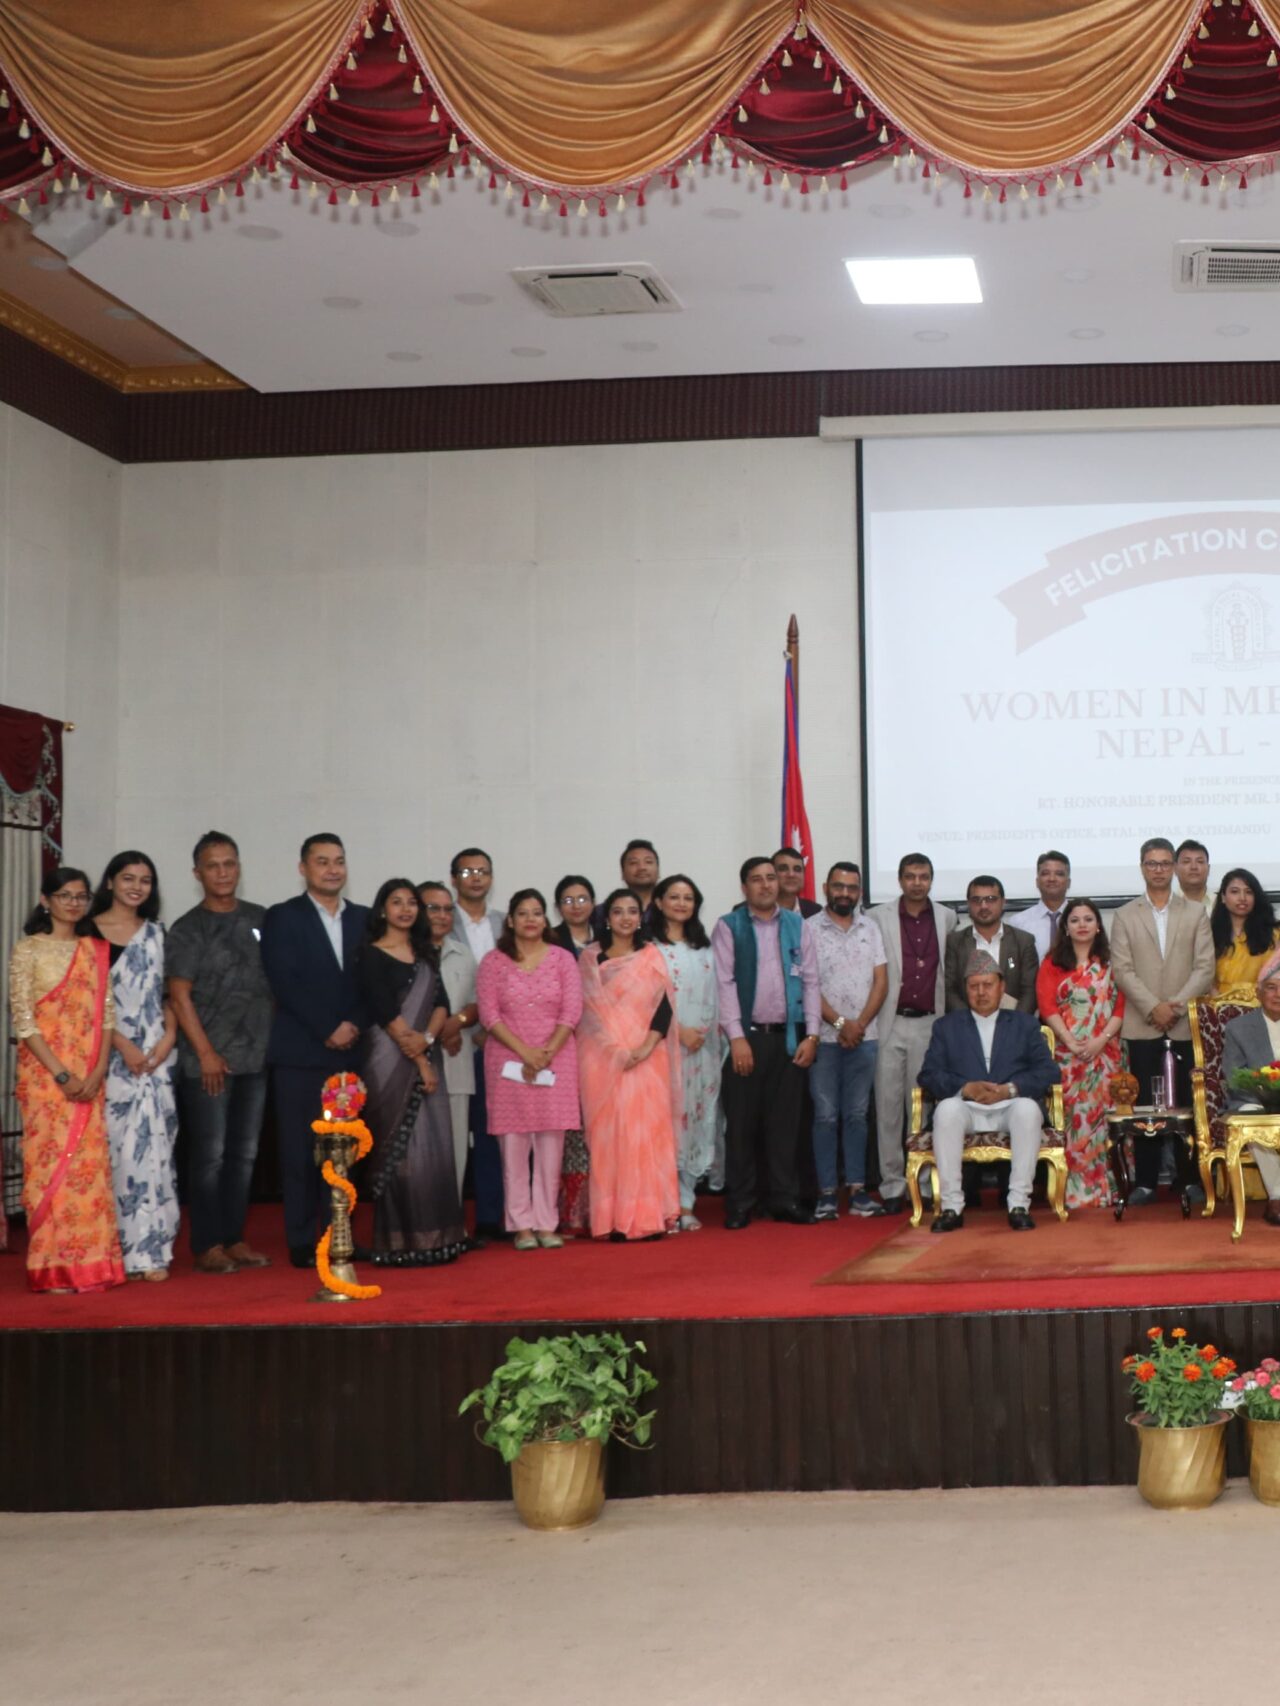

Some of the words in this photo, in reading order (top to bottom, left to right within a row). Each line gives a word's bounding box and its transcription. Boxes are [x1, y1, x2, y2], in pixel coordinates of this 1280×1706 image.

[1044, 527, 1247, 606] FELICITATION
[960, 687, 1146, 723] WOMEN
[1160, 686, 1208, 718] IN
[1096, 726, 1245, 760] NEPAL
[1199, 775, 1222, 786] THE
[1037, 796, 1062, 810] RT.
[1063, 794, 1155, 809] HONORABLE
[1158, 793, 1241, 807] PRESIDENT
[1244, 792, 1271, 805] MR.
